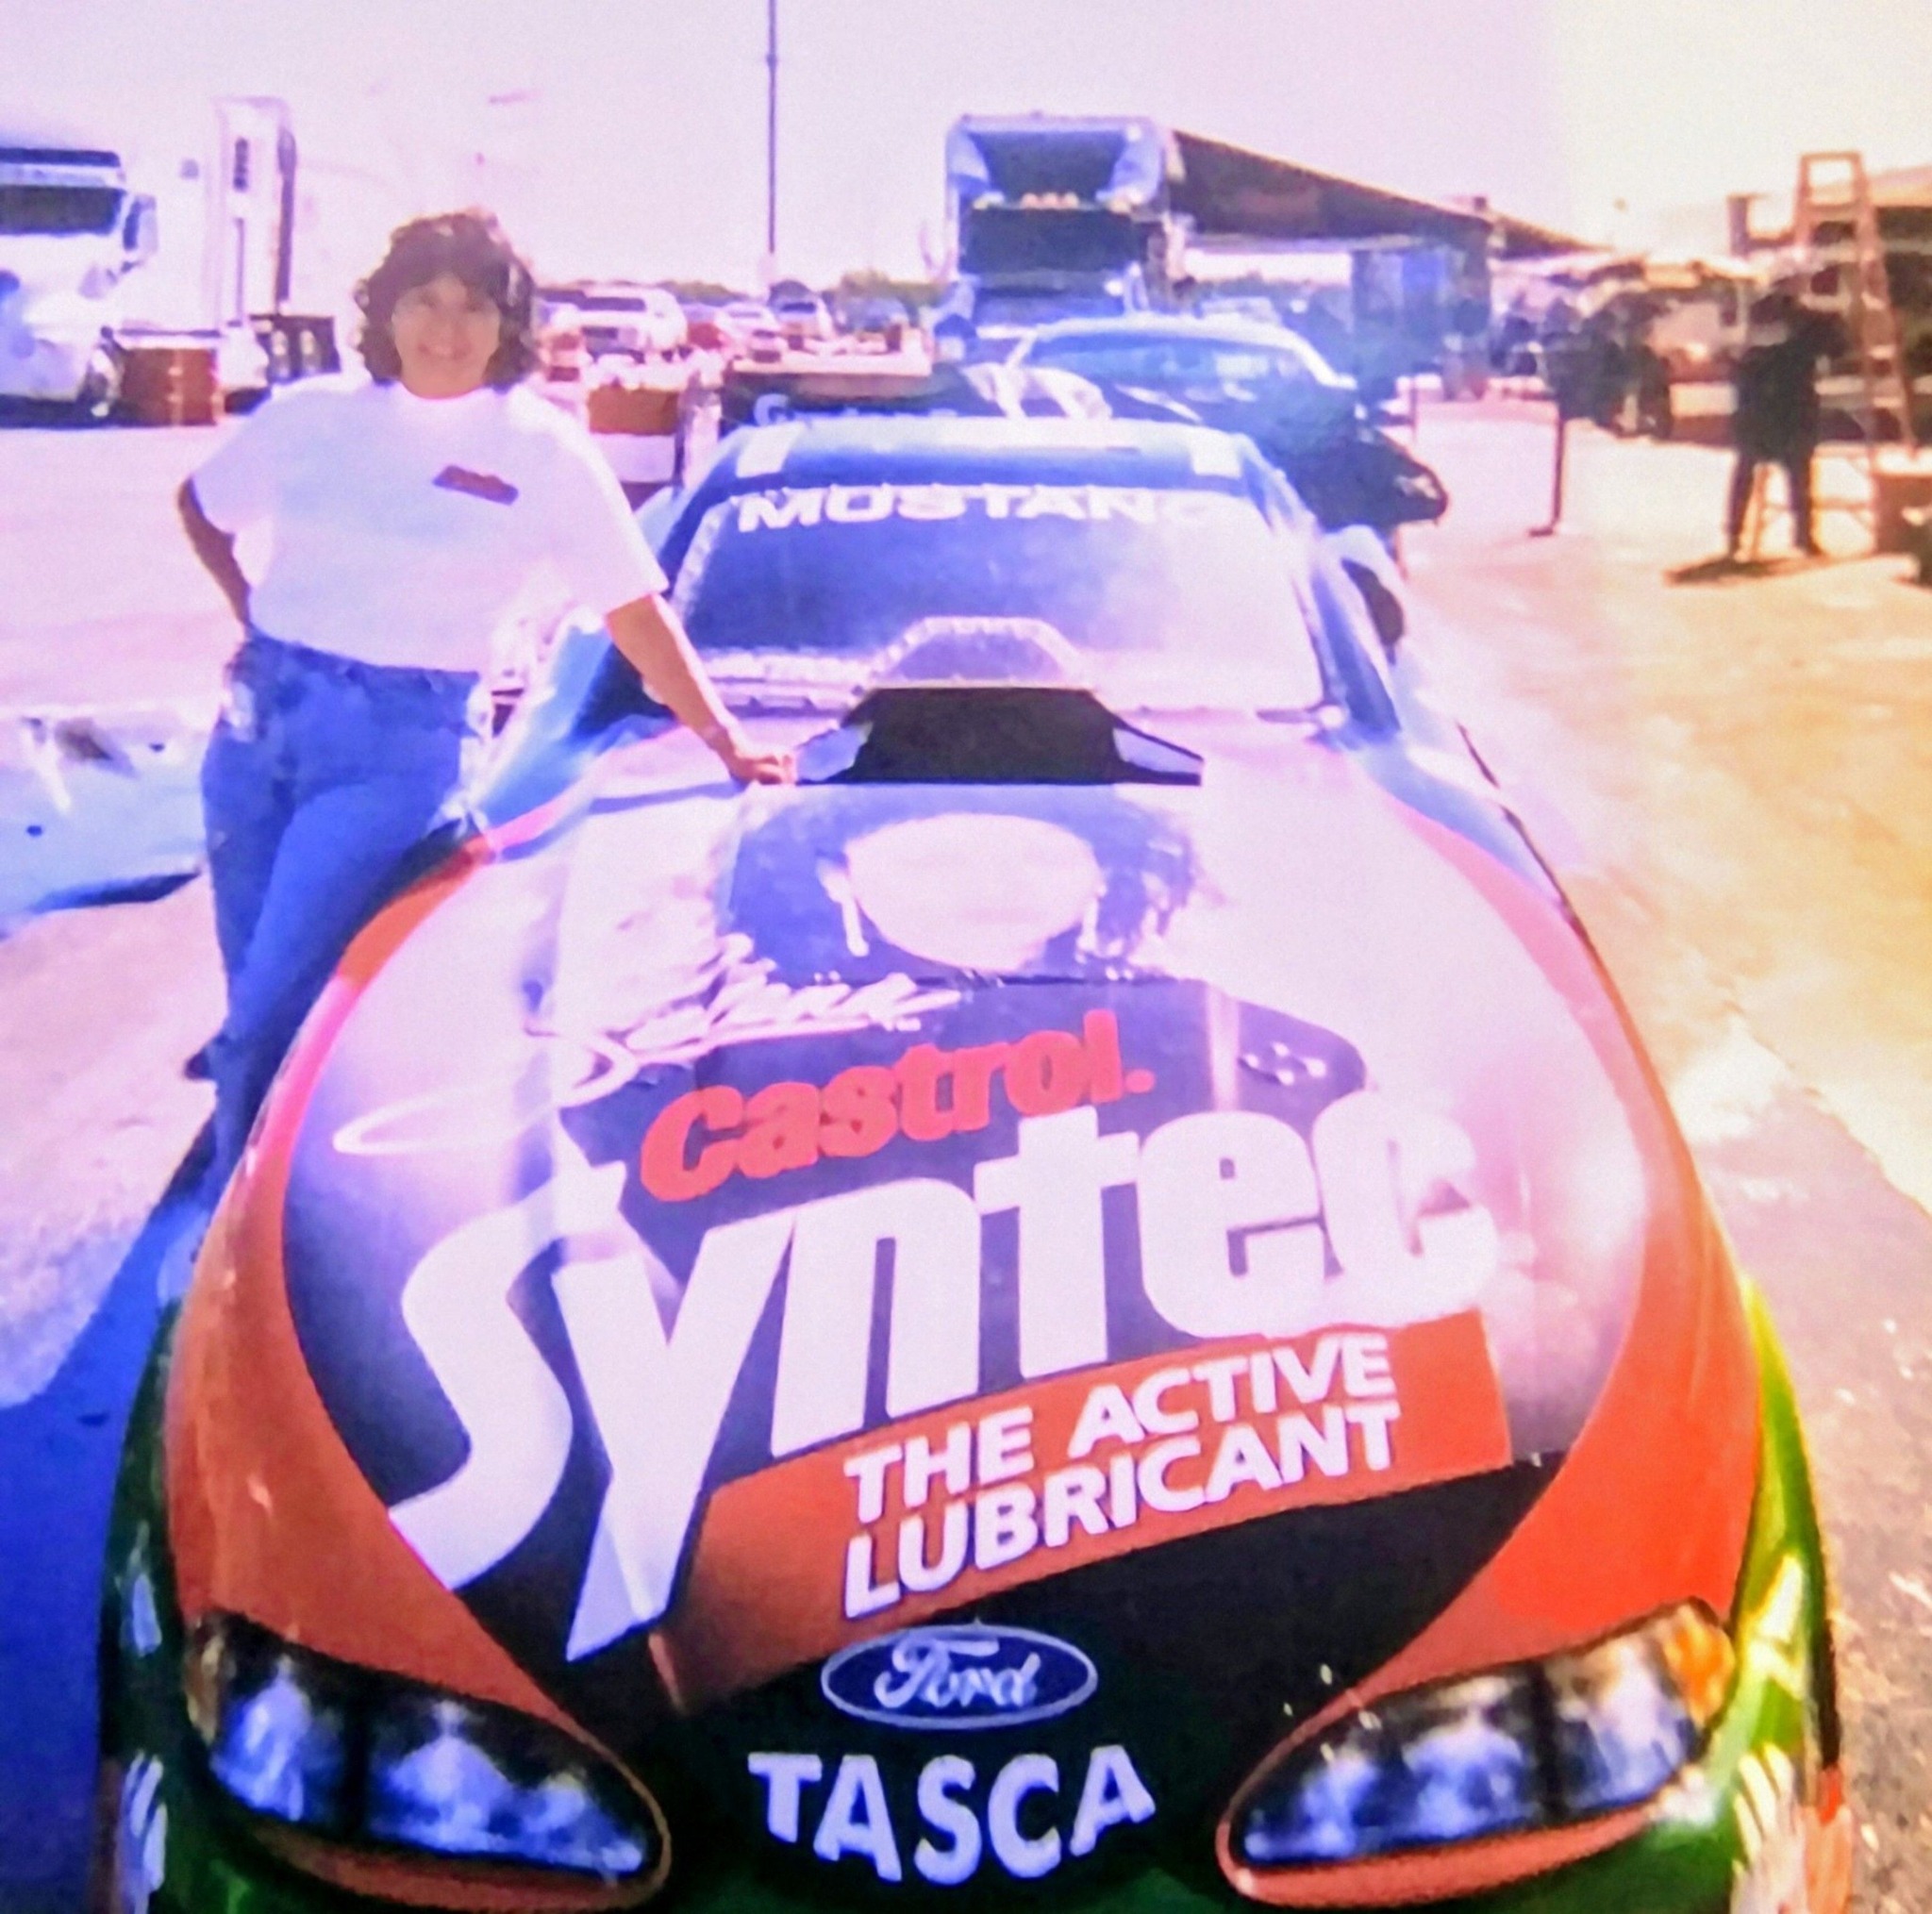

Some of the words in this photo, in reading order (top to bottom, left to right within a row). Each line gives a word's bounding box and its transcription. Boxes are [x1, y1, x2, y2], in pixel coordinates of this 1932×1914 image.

[388, 1087, 1498, 1659] Syntec
[843, 1405, 1035, 1523] THE
[1067, 1332, 1397, 1459] ACTIVE
[845, 1400, 1402, 1620] LUBRICANT
[874, 1638, 1041, 1708] Ford
[747, 1744, 1157, 1885] TASCA
